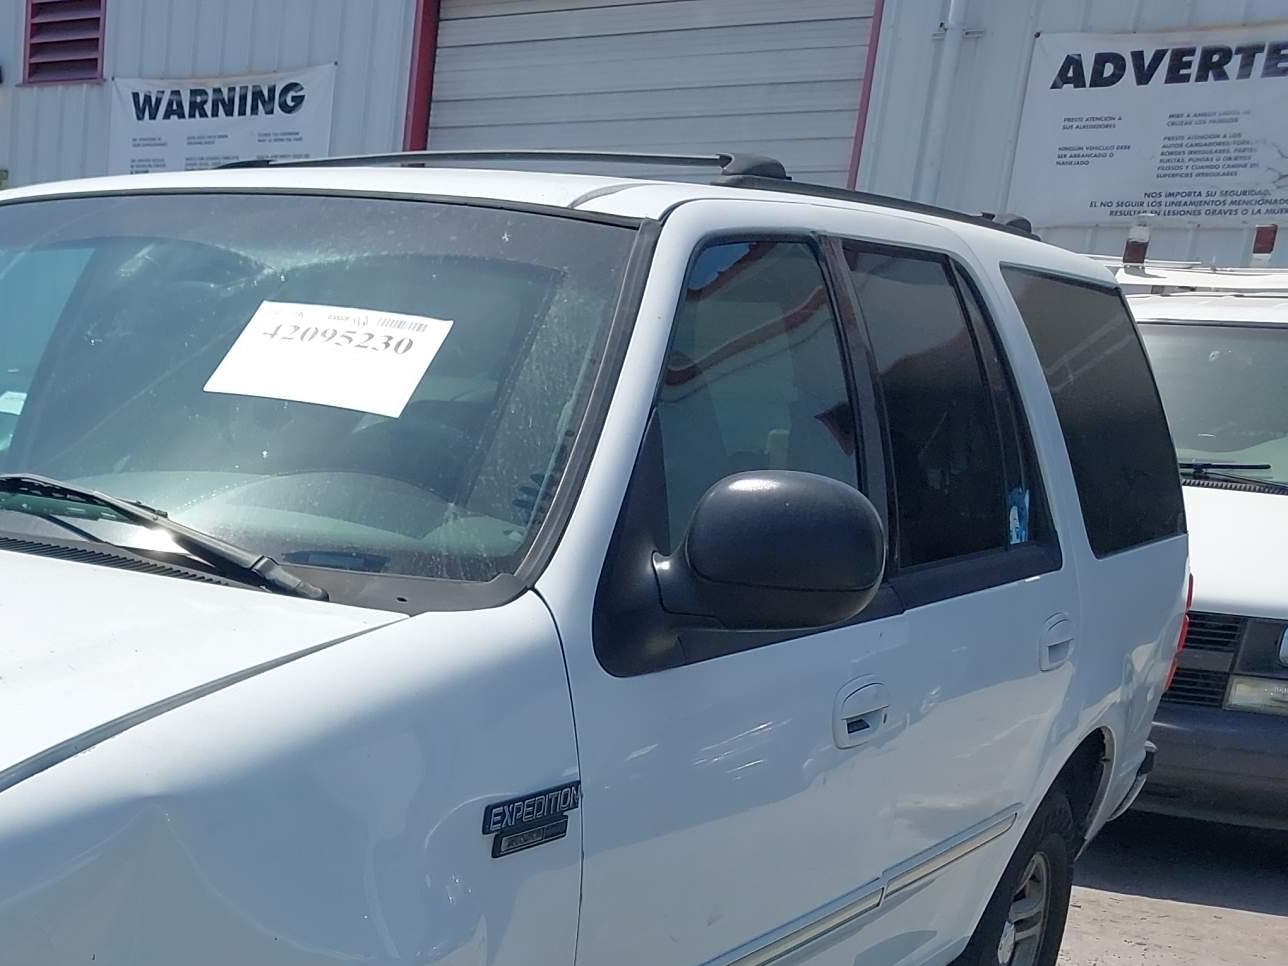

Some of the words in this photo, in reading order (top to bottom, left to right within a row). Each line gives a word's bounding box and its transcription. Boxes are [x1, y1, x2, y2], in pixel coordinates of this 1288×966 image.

[132, 82, 305, 121] WARNING
[1099, 200, 1114, 208] NO
[1115, 200, 1145, 208] SEGUIR
[1143, 191, 1163, 199] NOS
[1164, 190, 1202, 198] IMPORTA
[263, 323, 414, 356] 42095230
[489, 785, 581, 832] EXPEDITION
